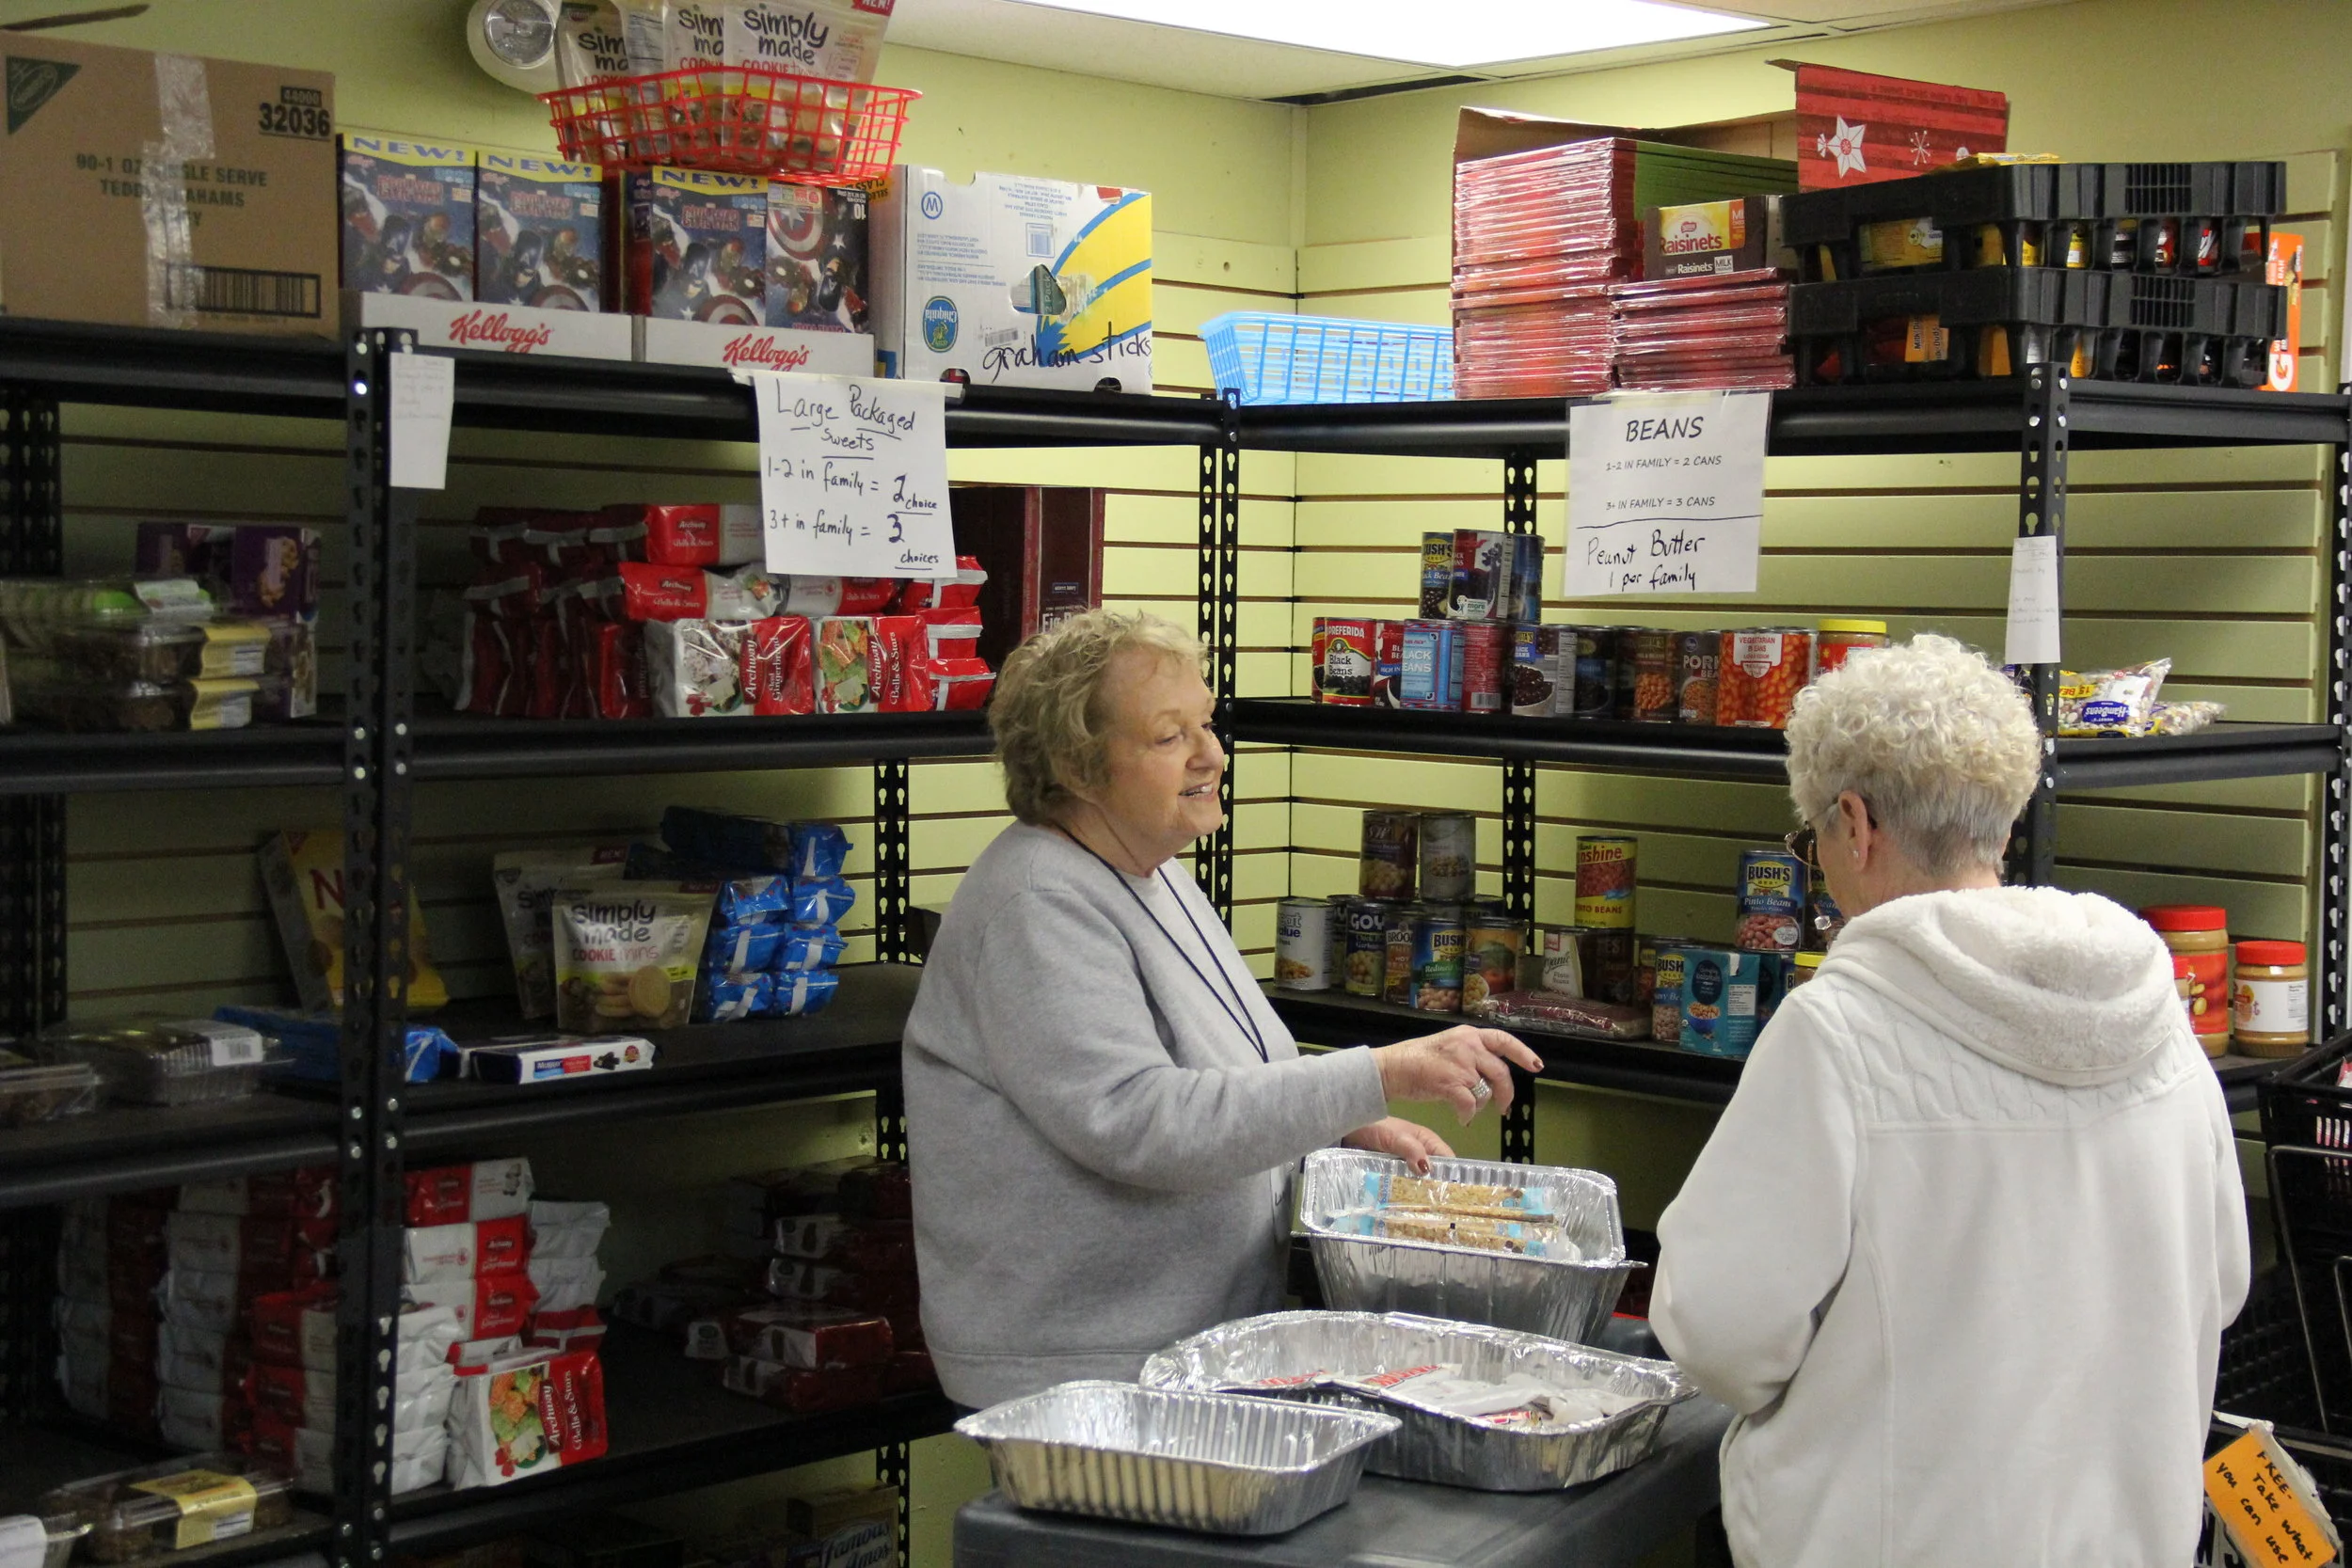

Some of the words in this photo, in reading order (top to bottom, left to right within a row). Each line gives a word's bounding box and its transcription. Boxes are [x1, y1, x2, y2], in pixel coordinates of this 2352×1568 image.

[743, 3, 829, 48] Simply
[758, 36, 816, 65] made
[258, 103, 330, 137] 32036
[353, 135, 465, 163] NEW!
[216, 166, 267, 187] SERVE
[487, 153, 593, 179] NEW!
[661, 169, 758, 189] NEW!
[1660, 232, 1723, 255] Raisinets
[1677, 261, 1713, 275] Raisinets
[925, 306, 958, 324] Chiquita
[449, 309, 551, 354] Kellogg's
[722, 333, 809, 372] Kellogg's
[982, 333, 1080, 384] graham
[1089, 321, 1152, 365] sticks
[775, 378, 839, 427] Large
[849, 384, 915, 434] Packaged
[1626, 416, 1704, 443] BEANS
[768, 456, 792, 478] 1-2
[801, 460, 814, 480] in
[823, 461, 864, 496] family
[1624, 460, 1634, 470] IN
[1636, 458, 1671, 468] FAMILY
[1683, 457, 1691, 467] 2
[1693, 455, 1723, 466] CANS
[905, 499, 937, 510] choice
[1617, 499, 1627, 510] IN
[1629, 498, 1664, 508] FAMILY
[1676, 498, 1683, 507] 3
[1686, 497, 1715, 507] CANS
[770, 510, 789, 529] 3+
[796, 514, 805, 530] in
[813, 509, 853, 546] family
[887, 514, 905, 544] 3
[900, 549, 939, 564] choices
[1587, 536, 1637, 565] Peanut
[1650, 529, 1706, 557] Butter
[1622, 572, 1643, 592] per
[1648, 562, 1695, 592] family
[745, 640, 757, 699] Archway
[870, 641, 883, 698] Archway
[1328, 654, 1352, 665] Black
[1328, 664, 1353, 676] Beans
[1748, 865, 1791, 881] BUSH'S
[571, 899, 657, 928] Simply
[1595, 904, 1623, 914] BEANS
[1743, 896, 1764, 905] Pinto
[1767, 897, 1791, 908] Beans
[583, 922, 651, 945] made
[572, 948, 616, 961] COOKIE
[543, 1385, 560, 1447] Archway
[2216, 1462, 2238, 1488] you
[2240, 1498, 2262, 1526] can
[2265, 1535, 2289, 1564] use
[2252, 1472, 2280, 1513] Take
[2281, 1519, 2313, 1561] what
